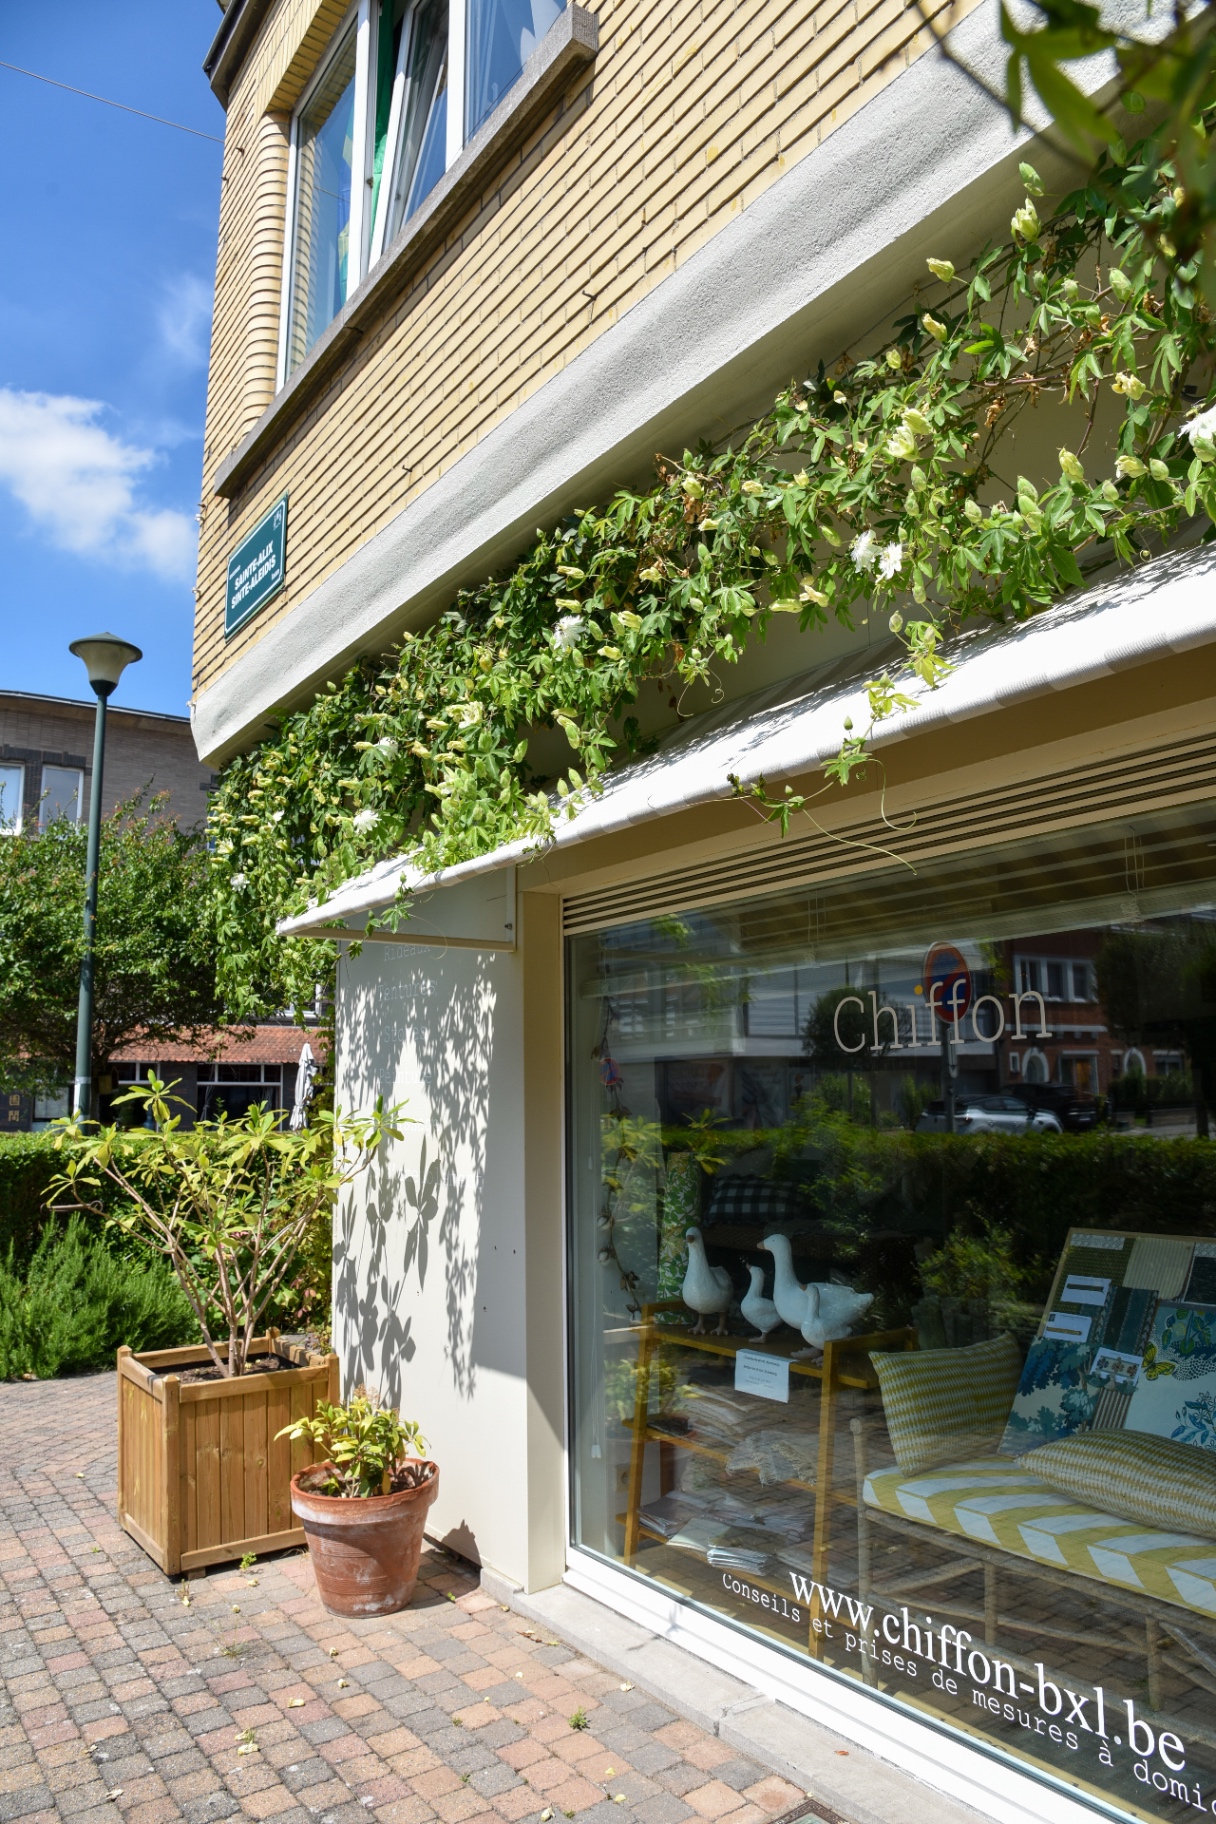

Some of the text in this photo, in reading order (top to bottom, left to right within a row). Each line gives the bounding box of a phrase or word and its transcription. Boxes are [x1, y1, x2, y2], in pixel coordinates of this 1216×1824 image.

[231, 554, 276, 609] SINTE-ALEIDIS
[234, 540, 274, 591] SAINTE-ALIX
[384, 1025, 428, 1043] Stoes
[833, 978, 1053, 1053] Chiffon
[722, 1573, 801, 1624] Conseils
[812, 1616, 834, 1639] et
[845, 1631, 918, 1678] prises
[932, 1669, 958, 1695] de
[972, 1689, 1080, 1751] mesures
[1098, 1740, 1115, 1767] à
[789, 1571, 1186, 1772] www.chiffon-bxl.be
